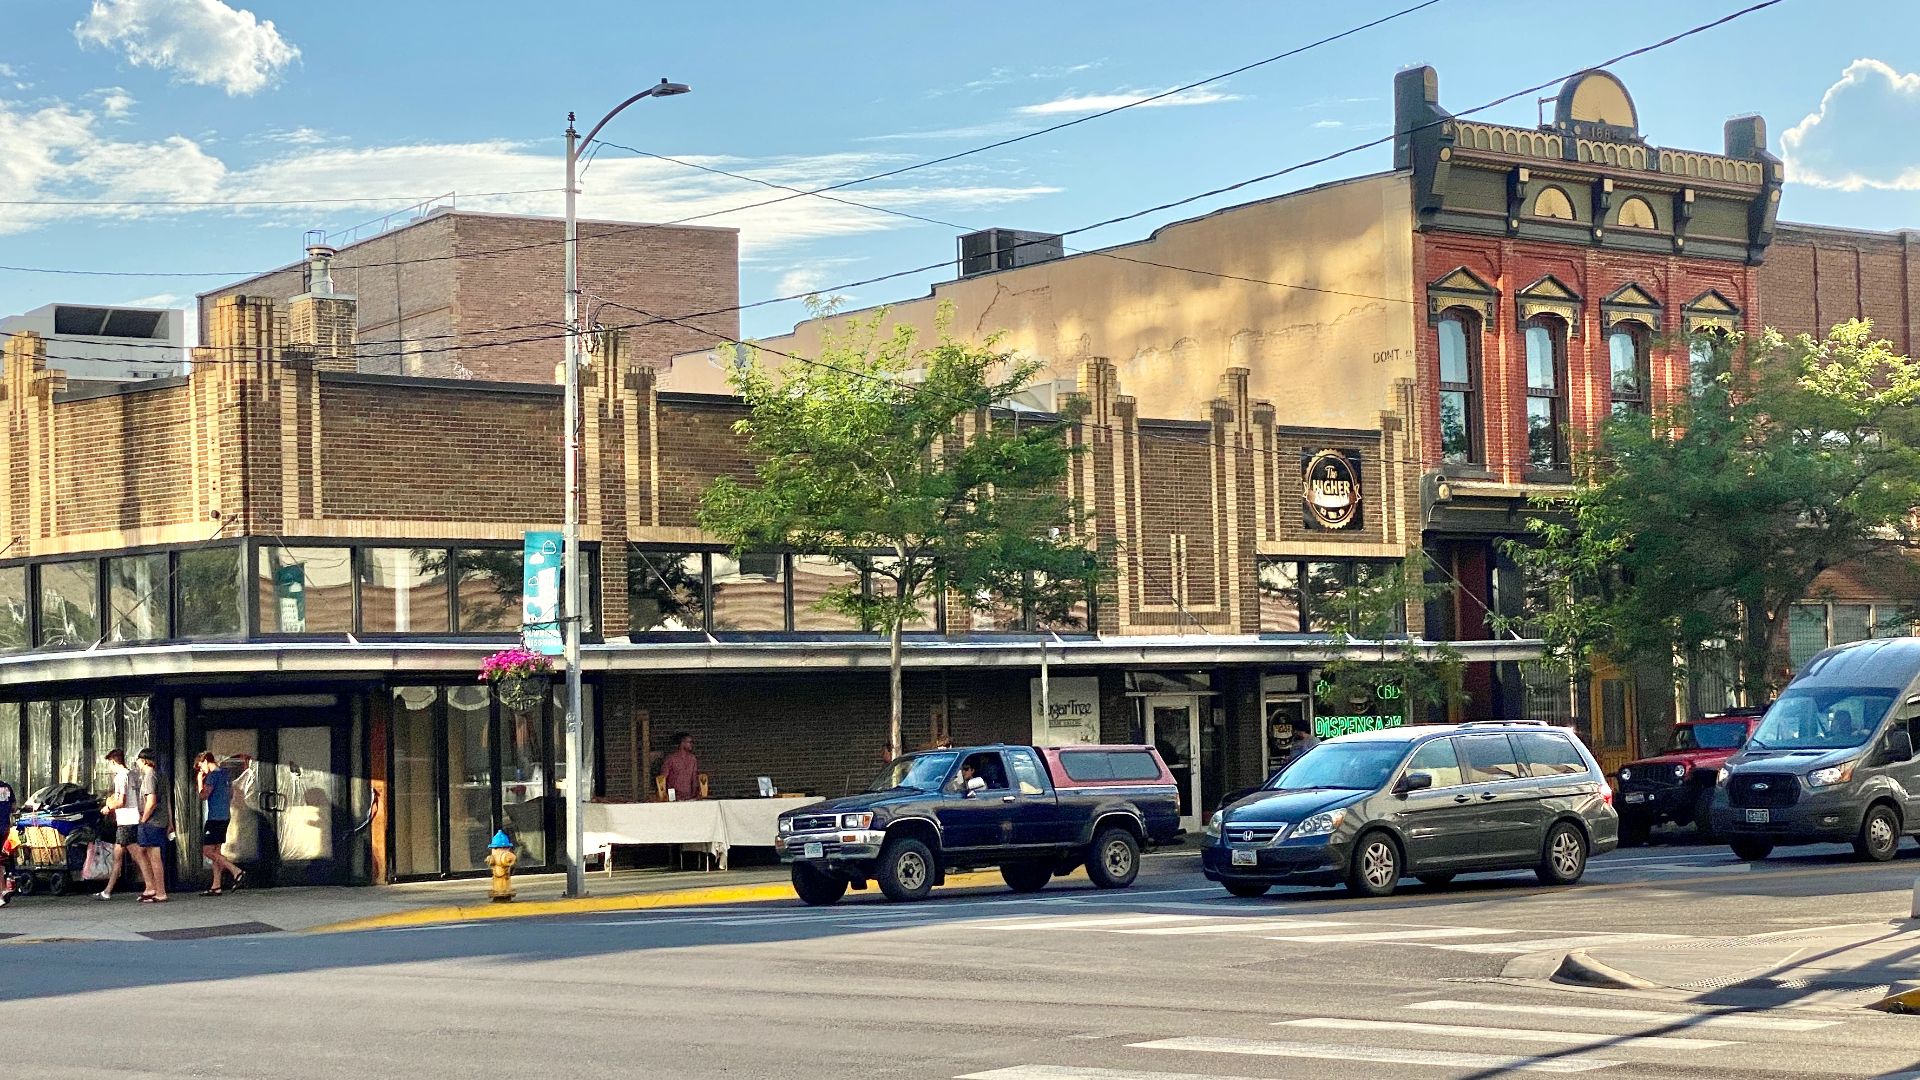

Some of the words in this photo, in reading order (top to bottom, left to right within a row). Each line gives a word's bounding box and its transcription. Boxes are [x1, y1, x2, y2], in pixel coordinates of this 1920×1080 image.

[1324, 465, 1338, 479] The
[1312, 479, 1351, 495] HIGHER
[1377, 684, 1401, 700] CBD
